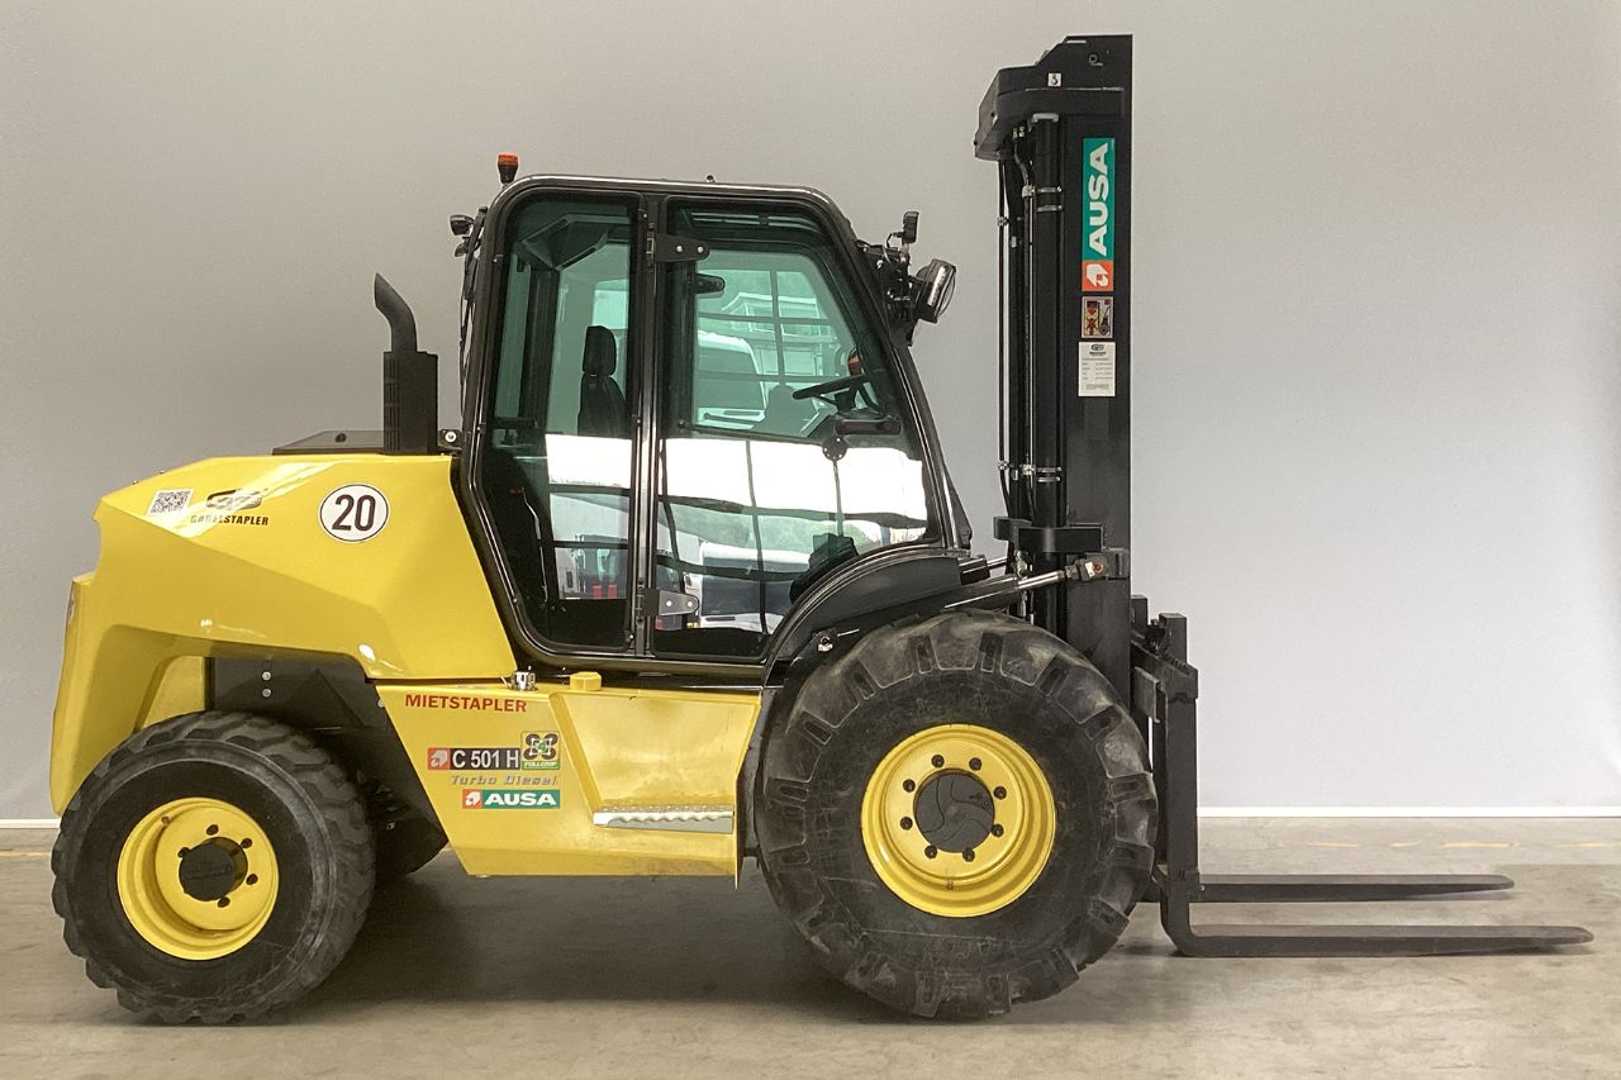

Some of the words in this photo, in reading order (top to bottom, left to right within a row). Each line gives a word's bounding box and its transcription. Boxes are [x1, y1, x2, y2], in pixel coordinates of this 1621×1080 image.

[1088, 143, 1109, 257] AUSA
[190, 514, 268, 526] GALSTAPLER
[332, 494, 376, 531] 20
[405, 694, 527, 712] MIETSTAPLER
[452, 750, 466, 768] C
[471, 750, 499, 768] 501
[506, 750, 519, 768] H
[452, 775, 497, 785] Turbo
[503, 775, 558, 786] Diesel
[485, 793, 556, 805] AUSA
